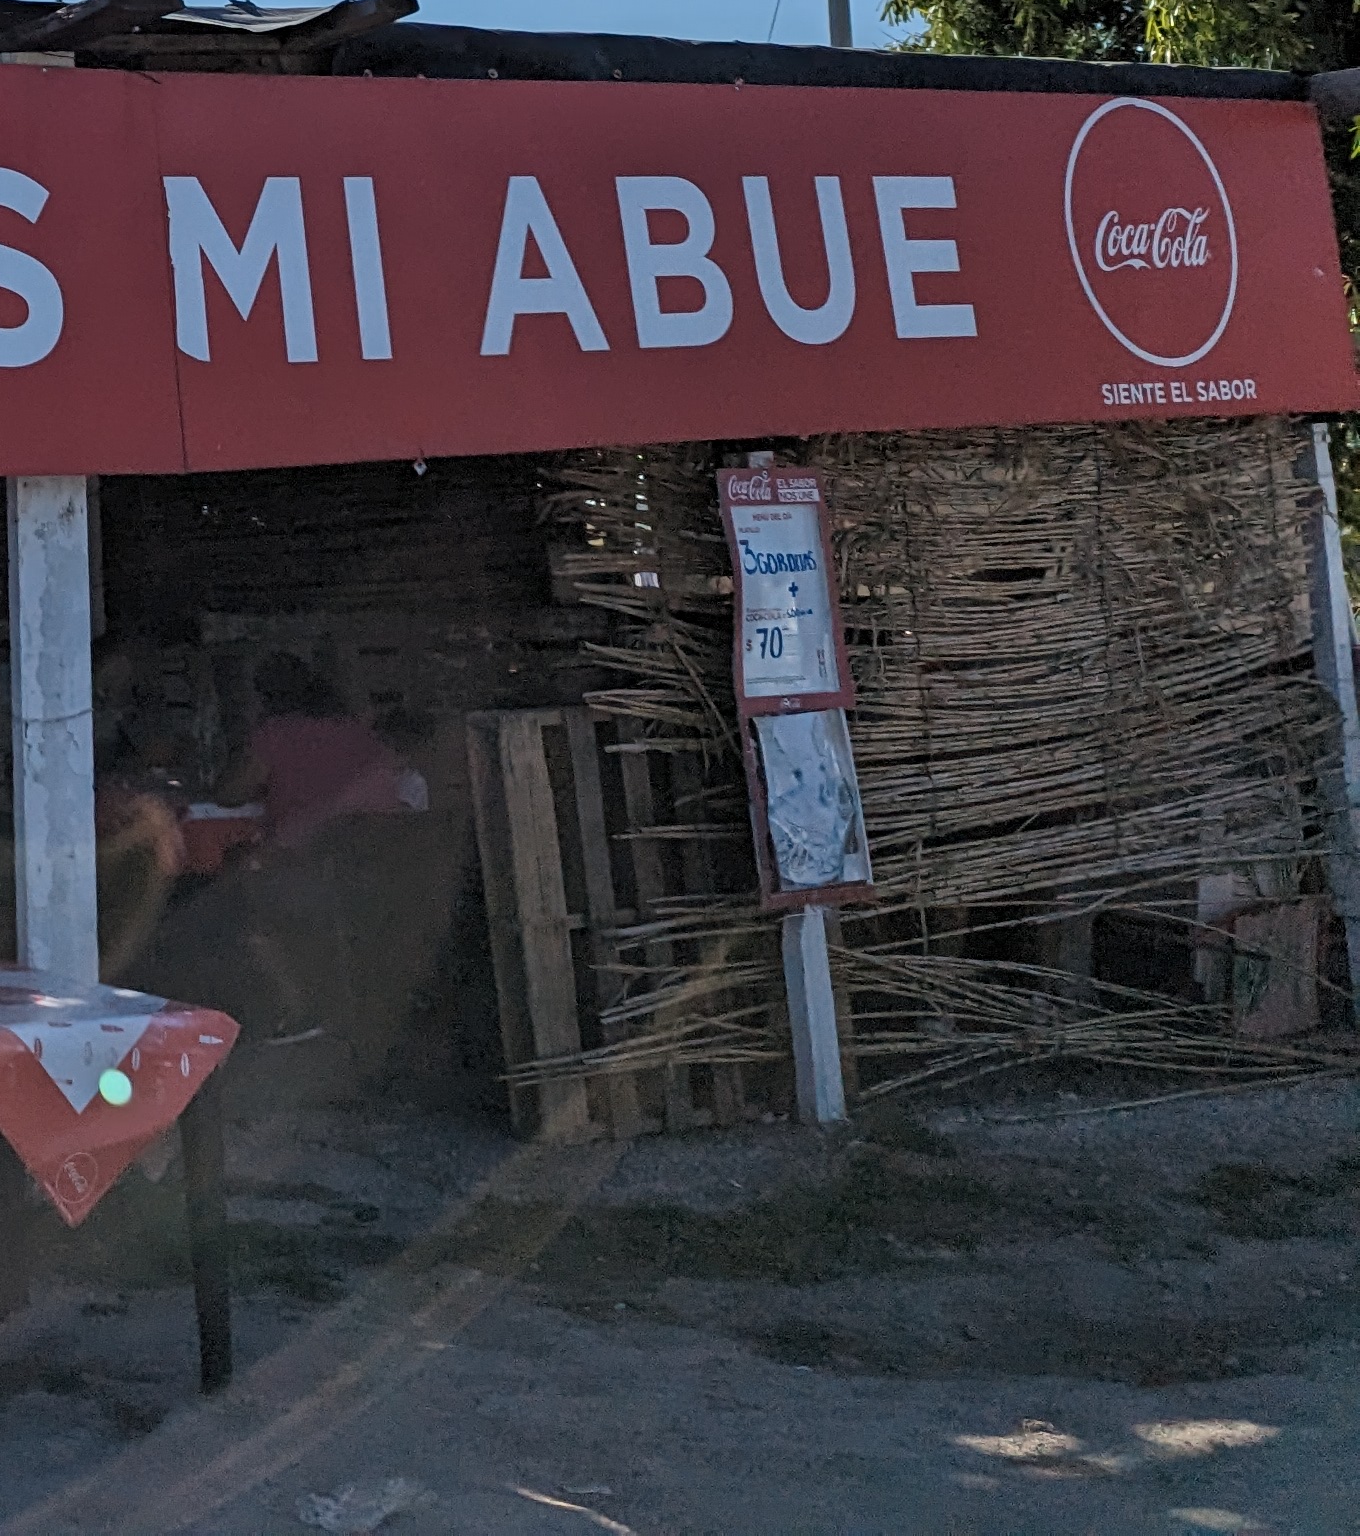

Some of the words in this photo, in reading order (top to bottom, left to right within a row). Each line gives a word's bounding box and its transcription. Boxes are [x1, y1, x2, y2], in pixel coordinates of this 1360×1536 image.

[163, 175, 394, 364] MI
[478, 174, 979, 357] ABUE
[1100, 382, 1167, 405] SIENTE
[1169, 381, 1194, 404] EL
[1196, 378, 1258, 403] SABOR
[756, 626, 783, 660] 70
